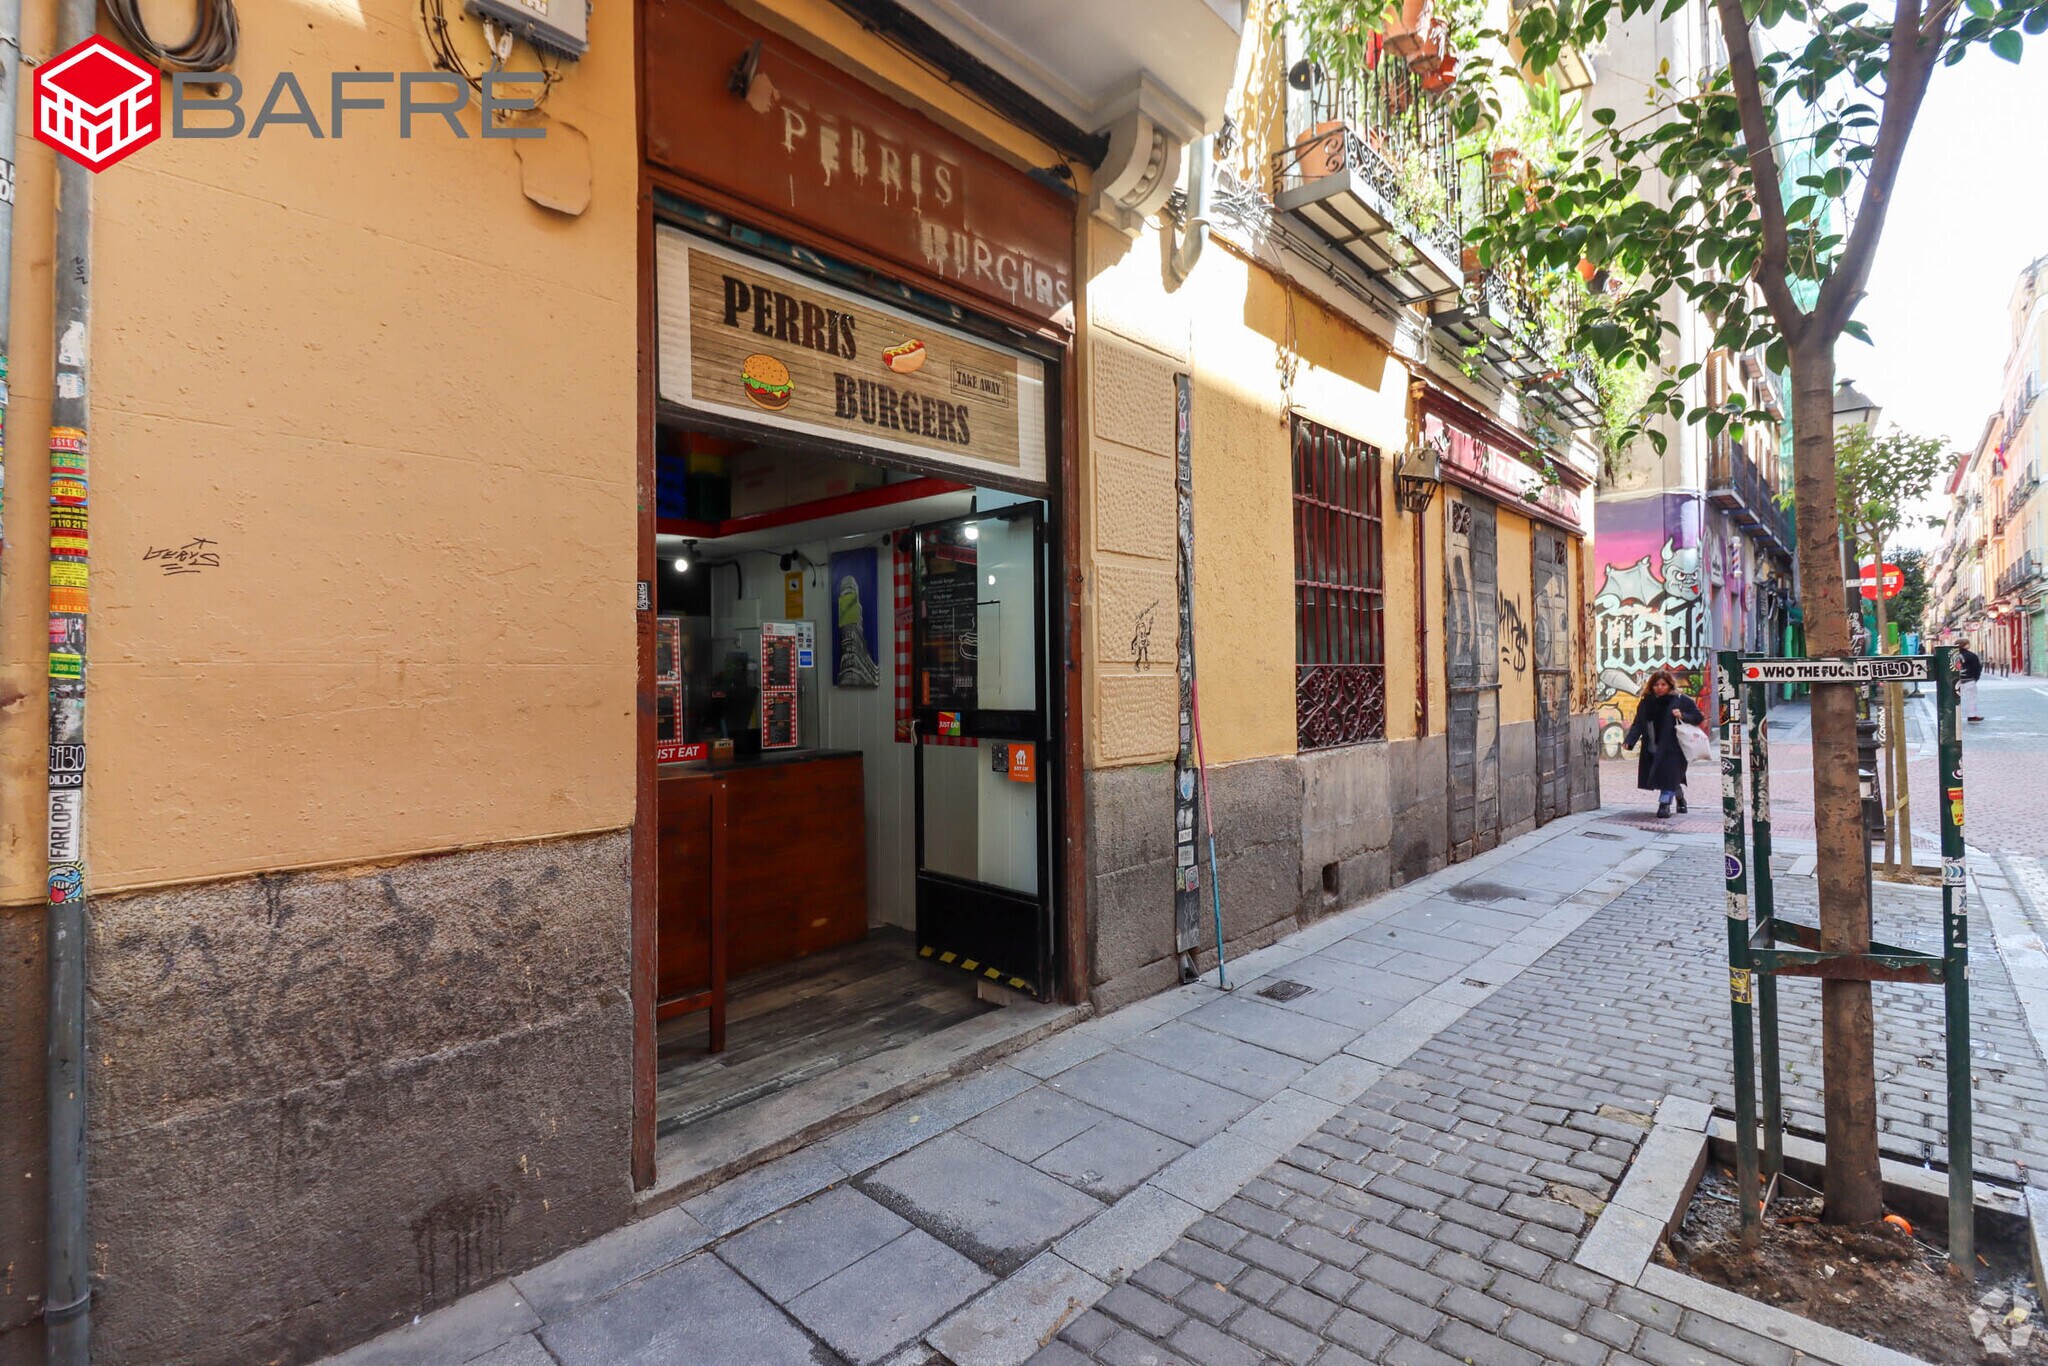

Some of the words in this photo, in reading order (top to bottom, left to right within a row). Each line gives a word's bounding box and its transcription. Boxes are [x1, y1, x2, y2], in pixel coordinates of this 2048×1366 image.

[722, 274, 857, 361] PERRIS
[957, 371, 978, 390] TAKE
[979, 376, 1001, 396] AWAY
[833, 372, 970, 446] BURGERS
[1763, 666, 1795, 678] WHO
[1797, 666, 1820, 678] THE
[1857, 665, 1869, 677] IS
[677, 746, 700, 758] EAT
[51, 793, 73, 858] FARLOPA
